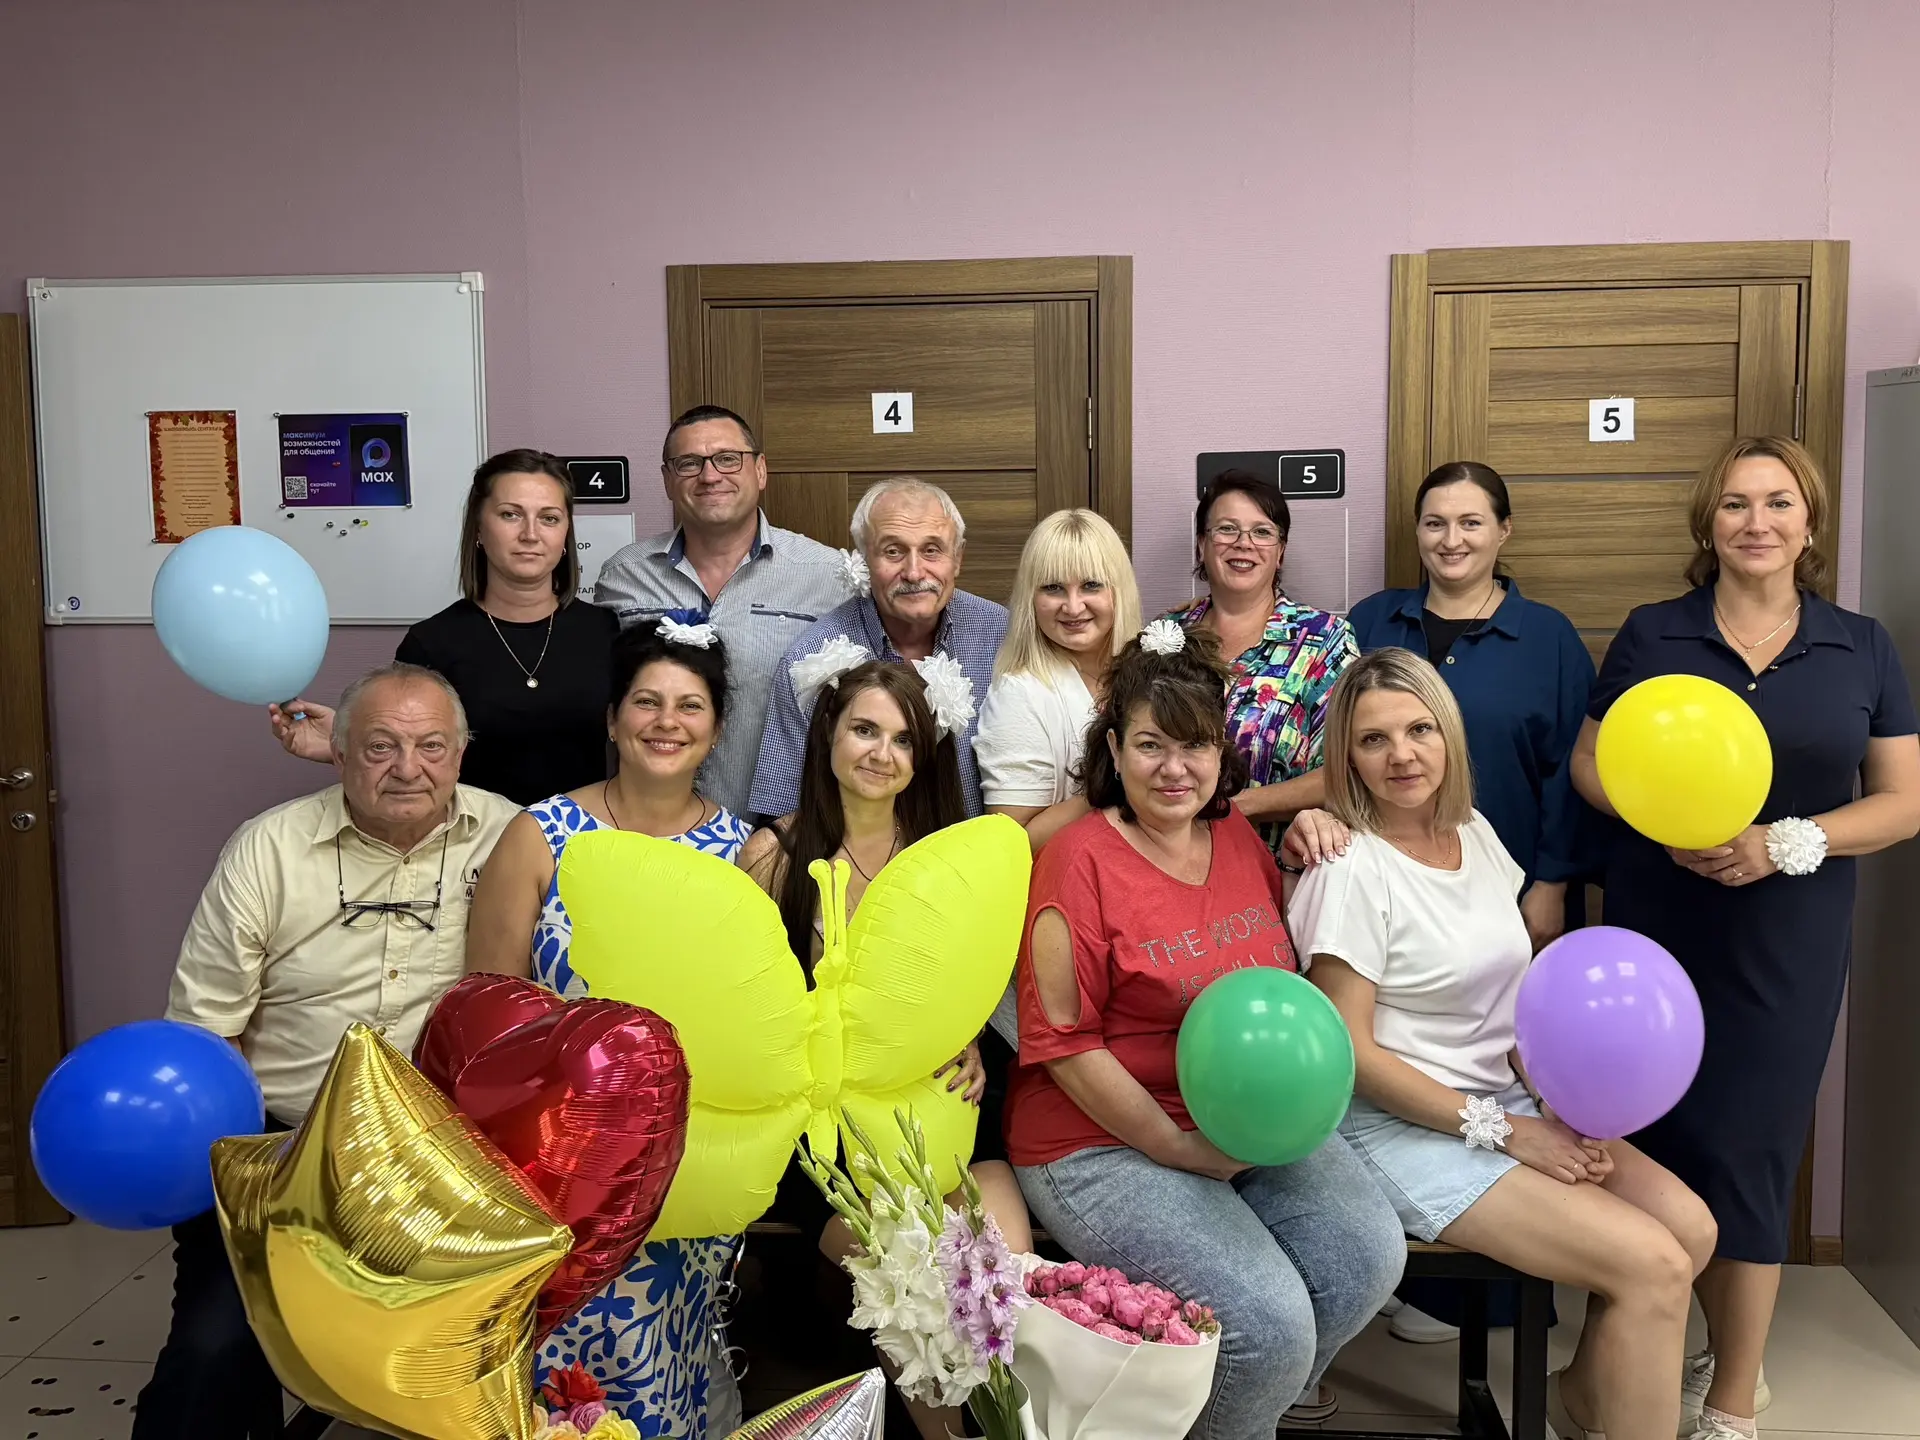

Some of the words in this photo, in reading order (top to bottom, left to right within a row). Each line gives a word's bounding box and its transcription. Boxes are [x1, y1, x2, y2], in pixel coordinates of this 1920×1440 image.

[884, 400, 902, 426] 4
[1602, 407, 1621, 434] 5
[283, 432, 326, 440] максимум
[283, 439, 341, 447] возможностей
[299, 448, 335, 456] общения
[588, 471, 605, 490] 4
[1302, 465, 1317, 484] 5
[1138, 929, 1208, 969] THE
